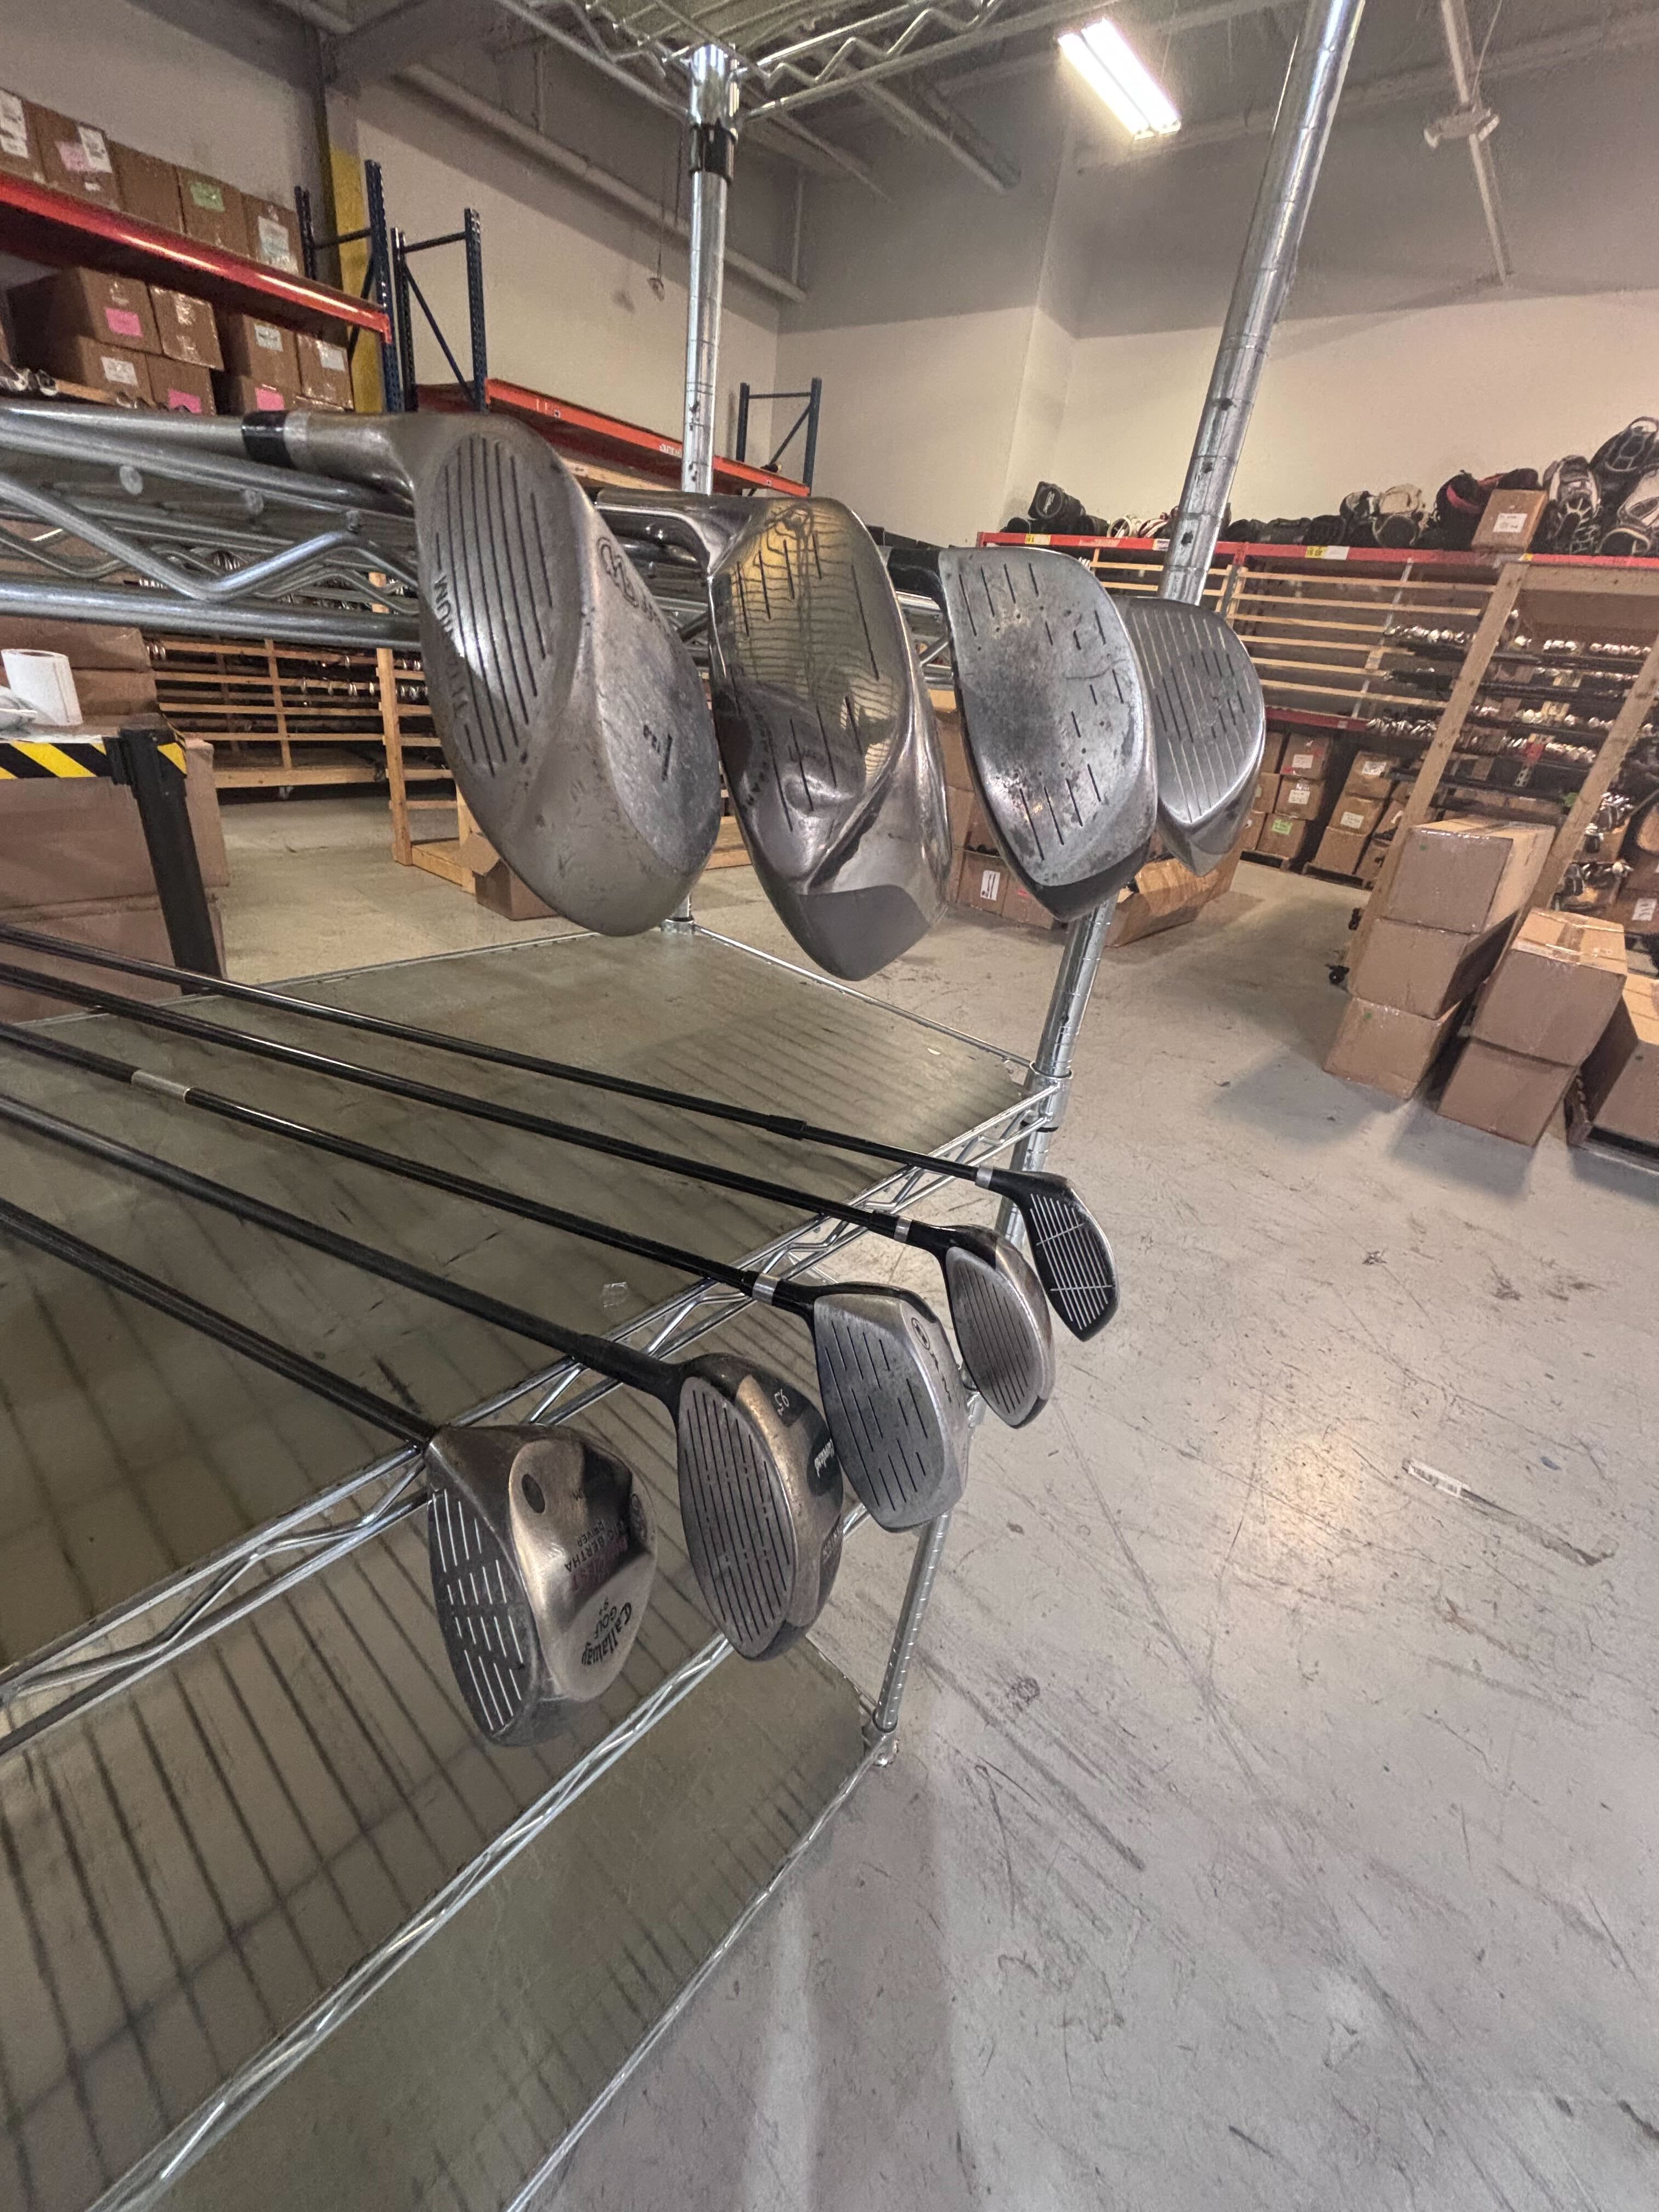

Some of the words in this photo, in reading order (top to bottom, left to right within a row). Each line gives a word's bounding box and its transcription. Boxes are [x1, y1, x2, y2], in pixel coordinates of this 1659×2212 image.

[434, 574, 467, 718] TITIUM
[577, 1521, 604, 1547] DRIVER
[564, 1537, 605, 1572] BERTHA
[582, 1602, 632, 1666] Callaway
[594, 1606, 617, 1640] GOLF
